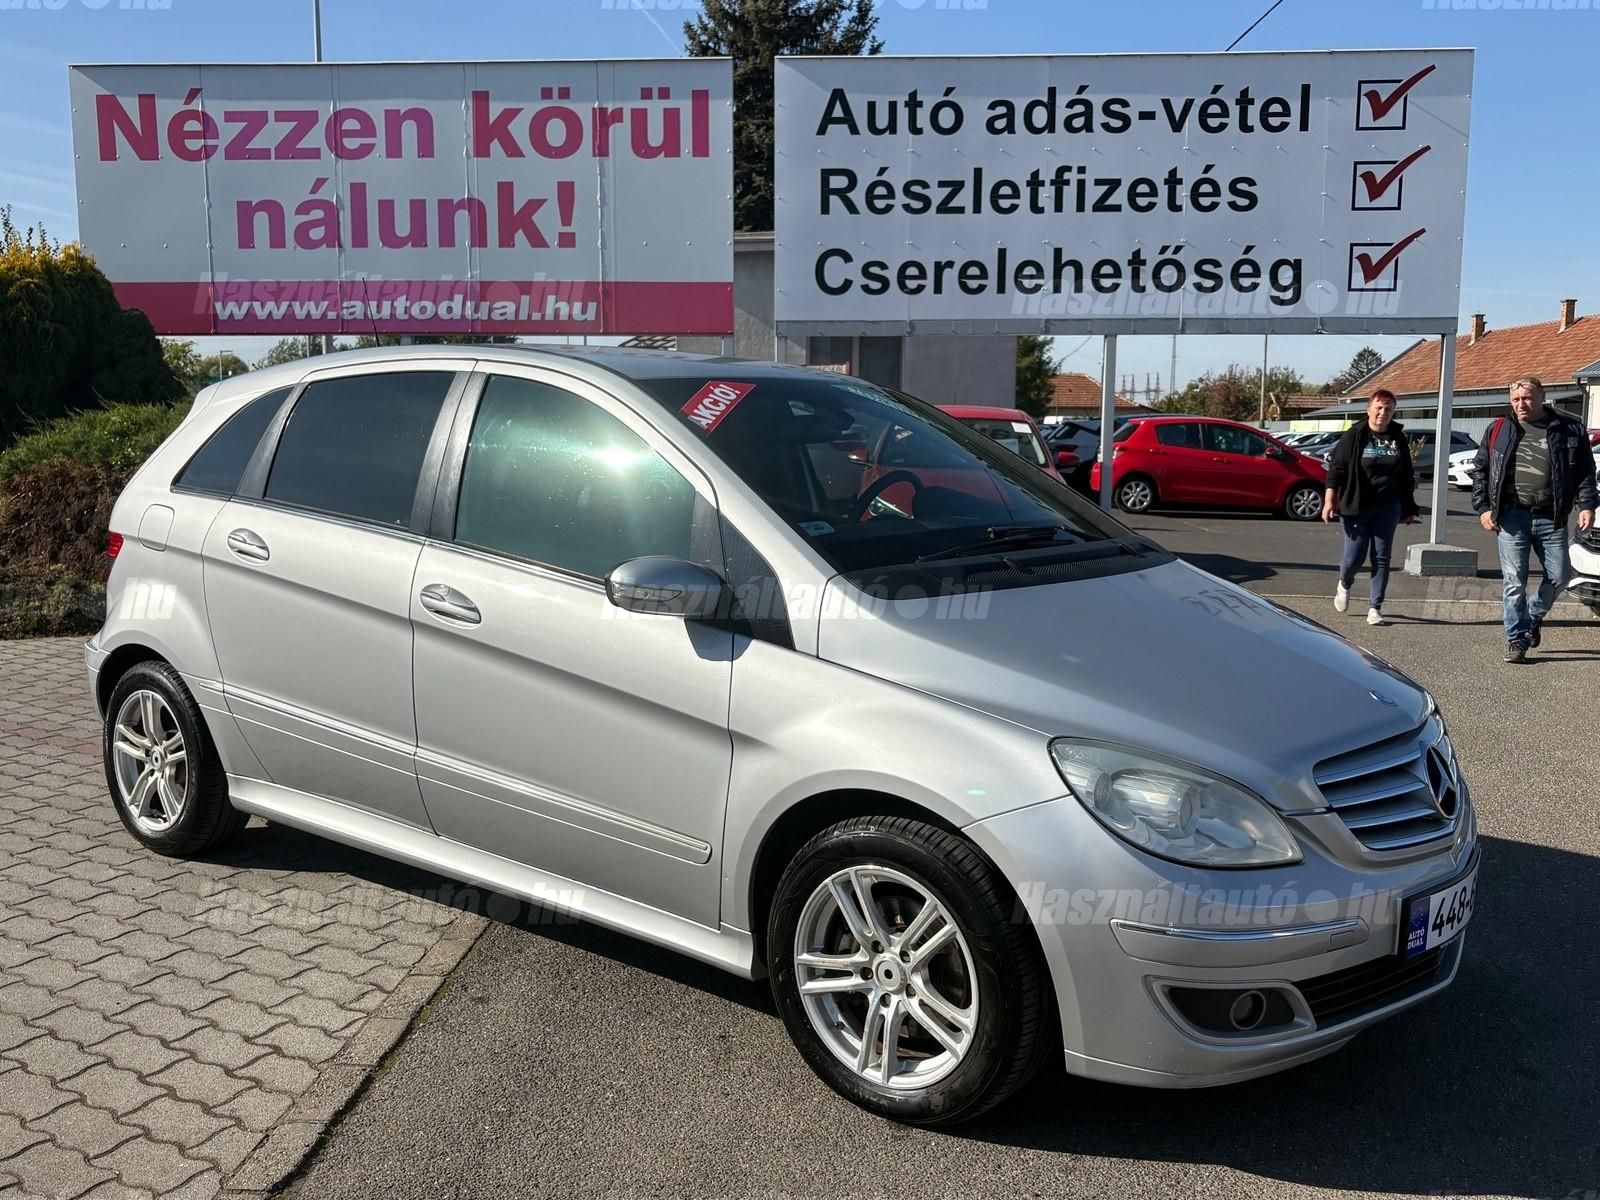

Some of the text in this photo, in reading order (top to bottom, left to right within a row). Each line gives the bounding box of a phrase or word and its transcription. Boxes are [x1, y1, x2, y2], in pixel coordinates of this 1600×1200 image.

[95, 85, 711, 162] Nézzen körül
[816, 82, 1311, 137] Autó adás-vétel
[236, 177, 577, 250] nálunk!
[820, 163, 1260, 216] Részletfizetés
[814, 244, 1304, 306] Cserelehetőség
[213, 293, 598, 322] www.autodual.hu
[688, 384, 741, 430] AKCIÓ!
